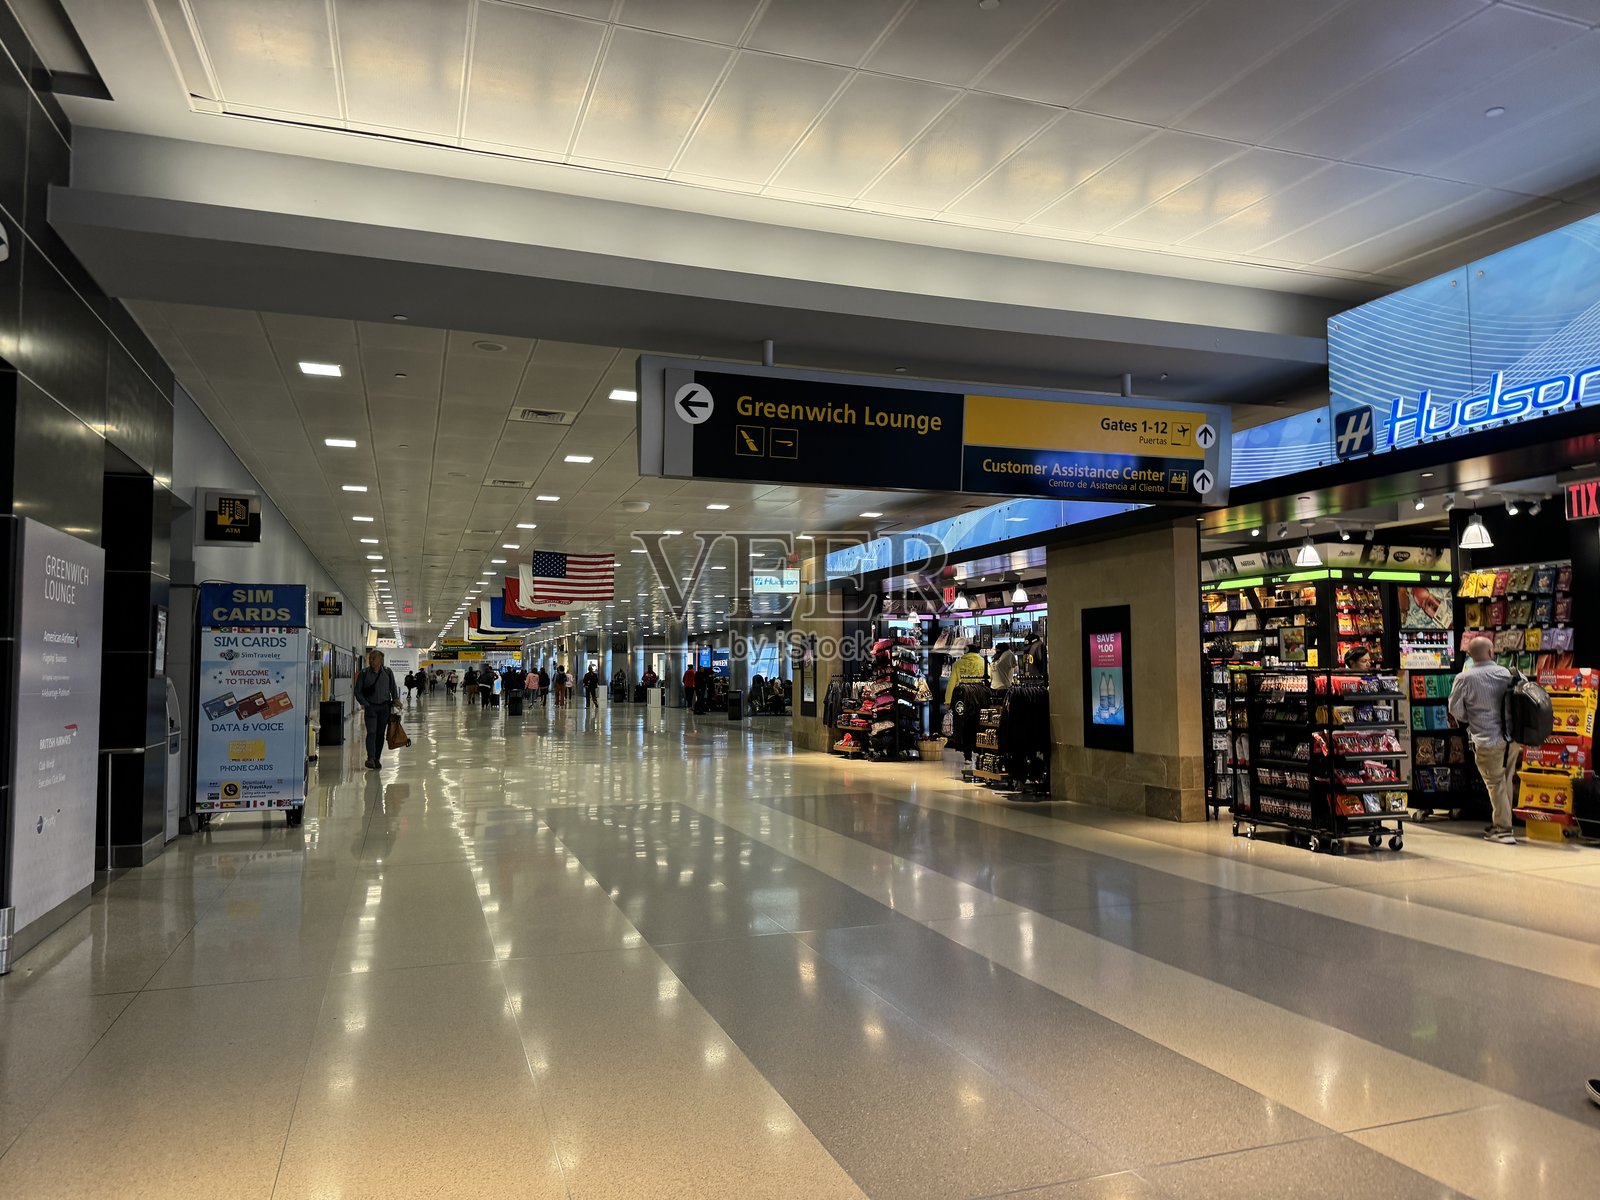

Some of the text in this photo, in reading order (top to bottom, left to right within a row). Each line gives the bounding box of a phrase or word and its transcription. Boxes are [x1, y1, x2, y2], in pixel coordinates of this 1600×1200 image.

[736, 395, 942, 435] Greenwich Lounge
[1100, 417, 1168, 434] Gates 1-12
[1139, 435, 1167, 446] Puertas
[982, 459, 1165, 482] Customer Assistance Center
[1048, 478, 1165, 493] Centro de Asistencia al Cliente
[45, 554, 90, 586] GREENWICH
[44, 578, 76, 605] LOUNGE
[232, 589, 274, 603] SIM
[212, 607, 291, 621] CARDS
[214, 636, 287, 648] SIM CARDS
[1096, 633, 1115, 643] SAVE
[211, 722, 284, 732] DATA & VOICE
